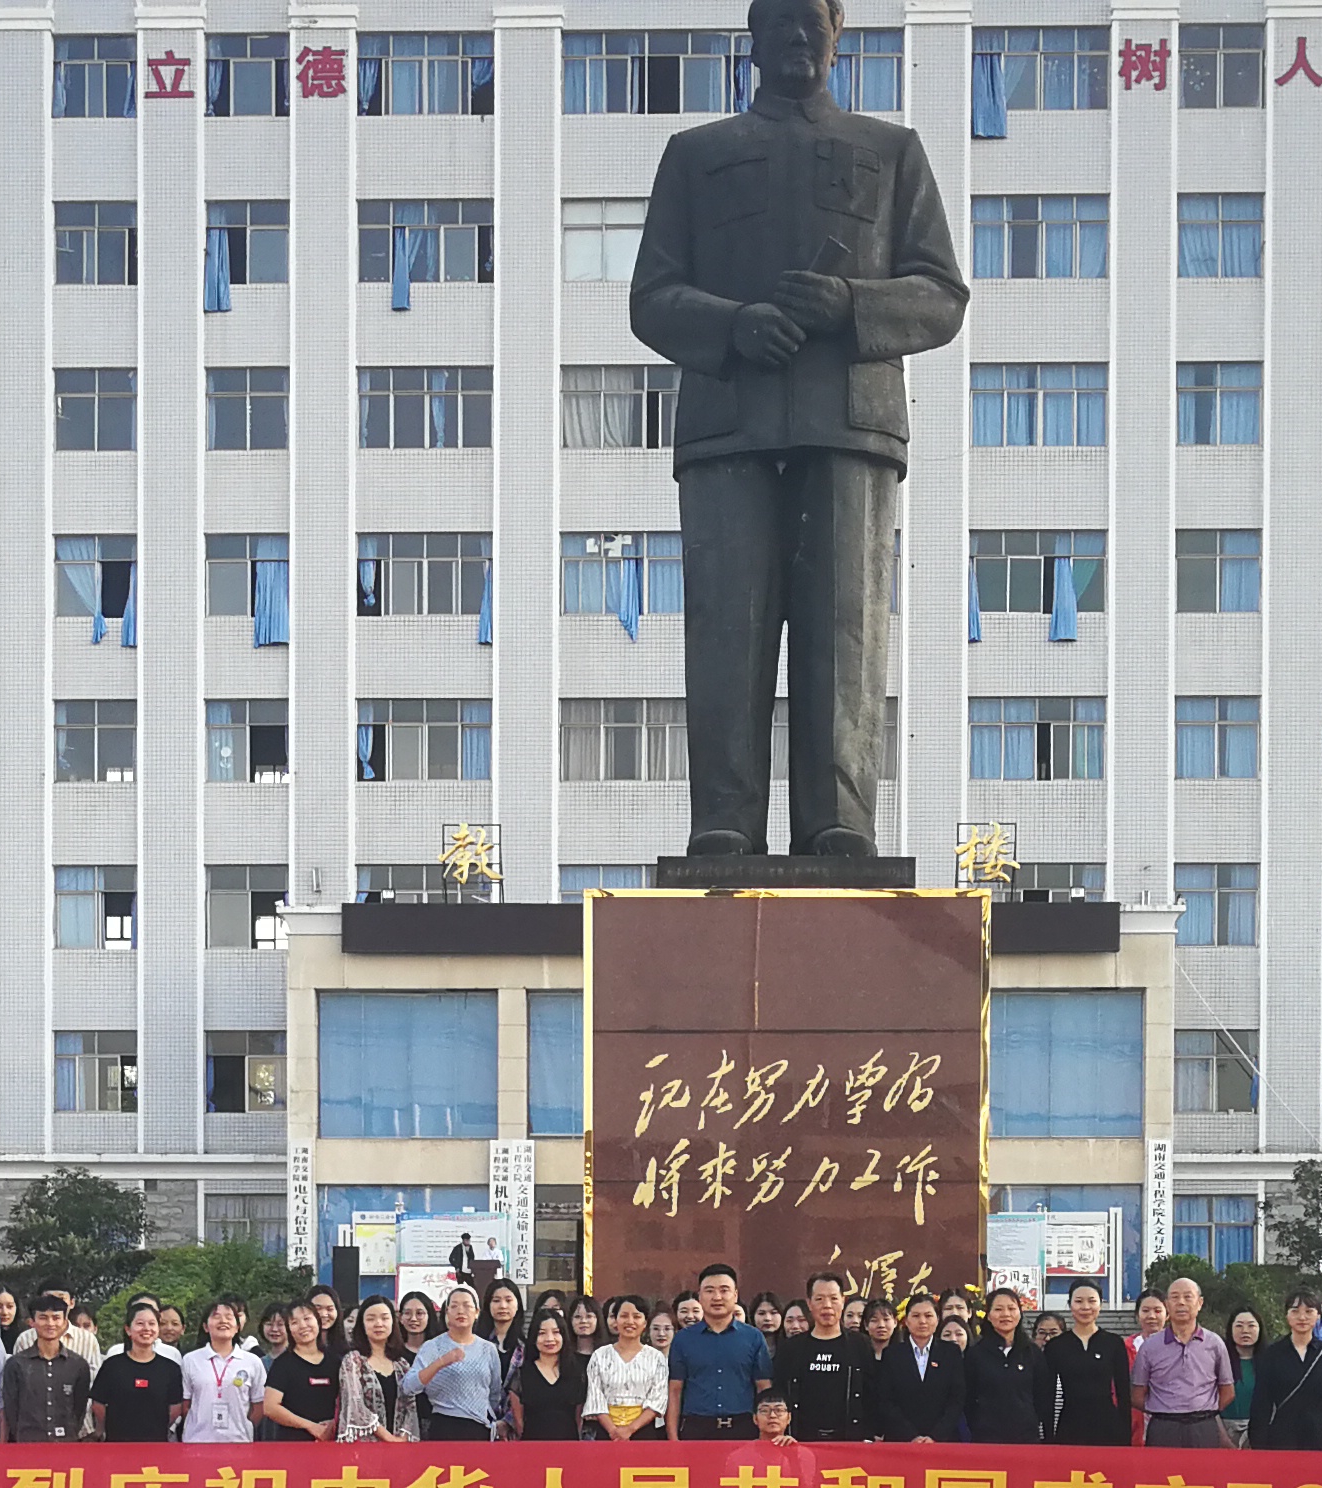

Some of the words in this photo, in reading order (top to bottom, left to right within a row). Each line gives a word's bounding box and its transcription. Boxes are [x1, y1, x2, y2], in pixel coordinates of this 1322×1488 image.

[516, 1185, 529, 1280] 交通运输工程学院
[816, 1353, 833, 1362] ANY
[809, 1362, 840, 1372] DOUBT?
